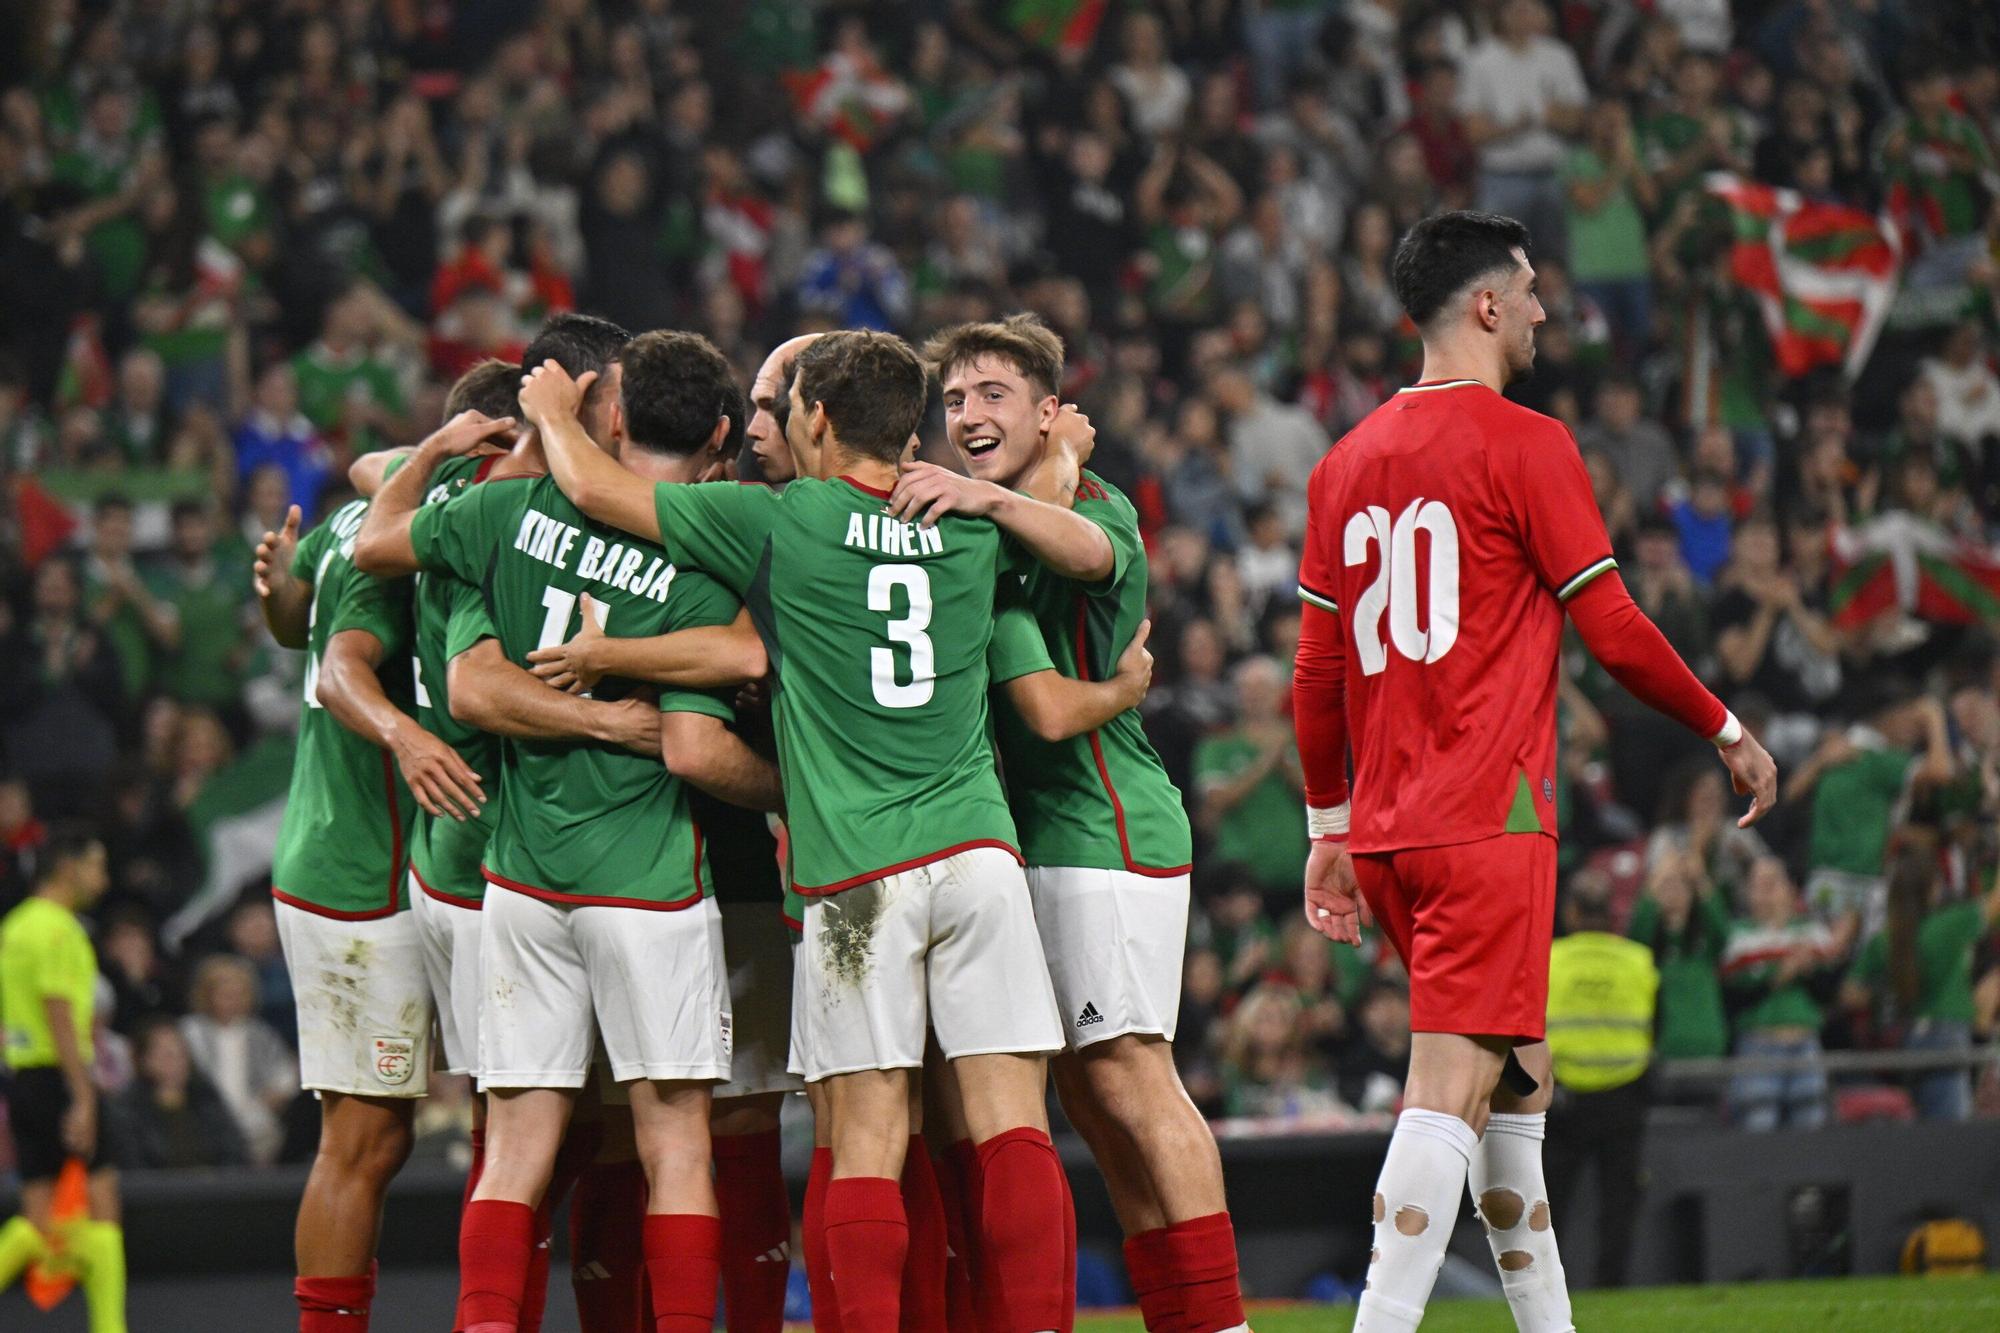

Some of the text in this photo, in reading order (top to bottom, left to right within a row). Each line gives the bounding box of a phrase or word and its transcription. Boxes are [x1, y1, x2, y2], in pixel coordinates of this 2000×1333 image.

[513, 508, 678, 604] KIKE BARJA
[844, 511, 944, 556] AIHEN
[1343, 496, 1460, 677] 20
[867, 563, 937, 709] 3
[1076, 1014, 1104, 1028] adidas
